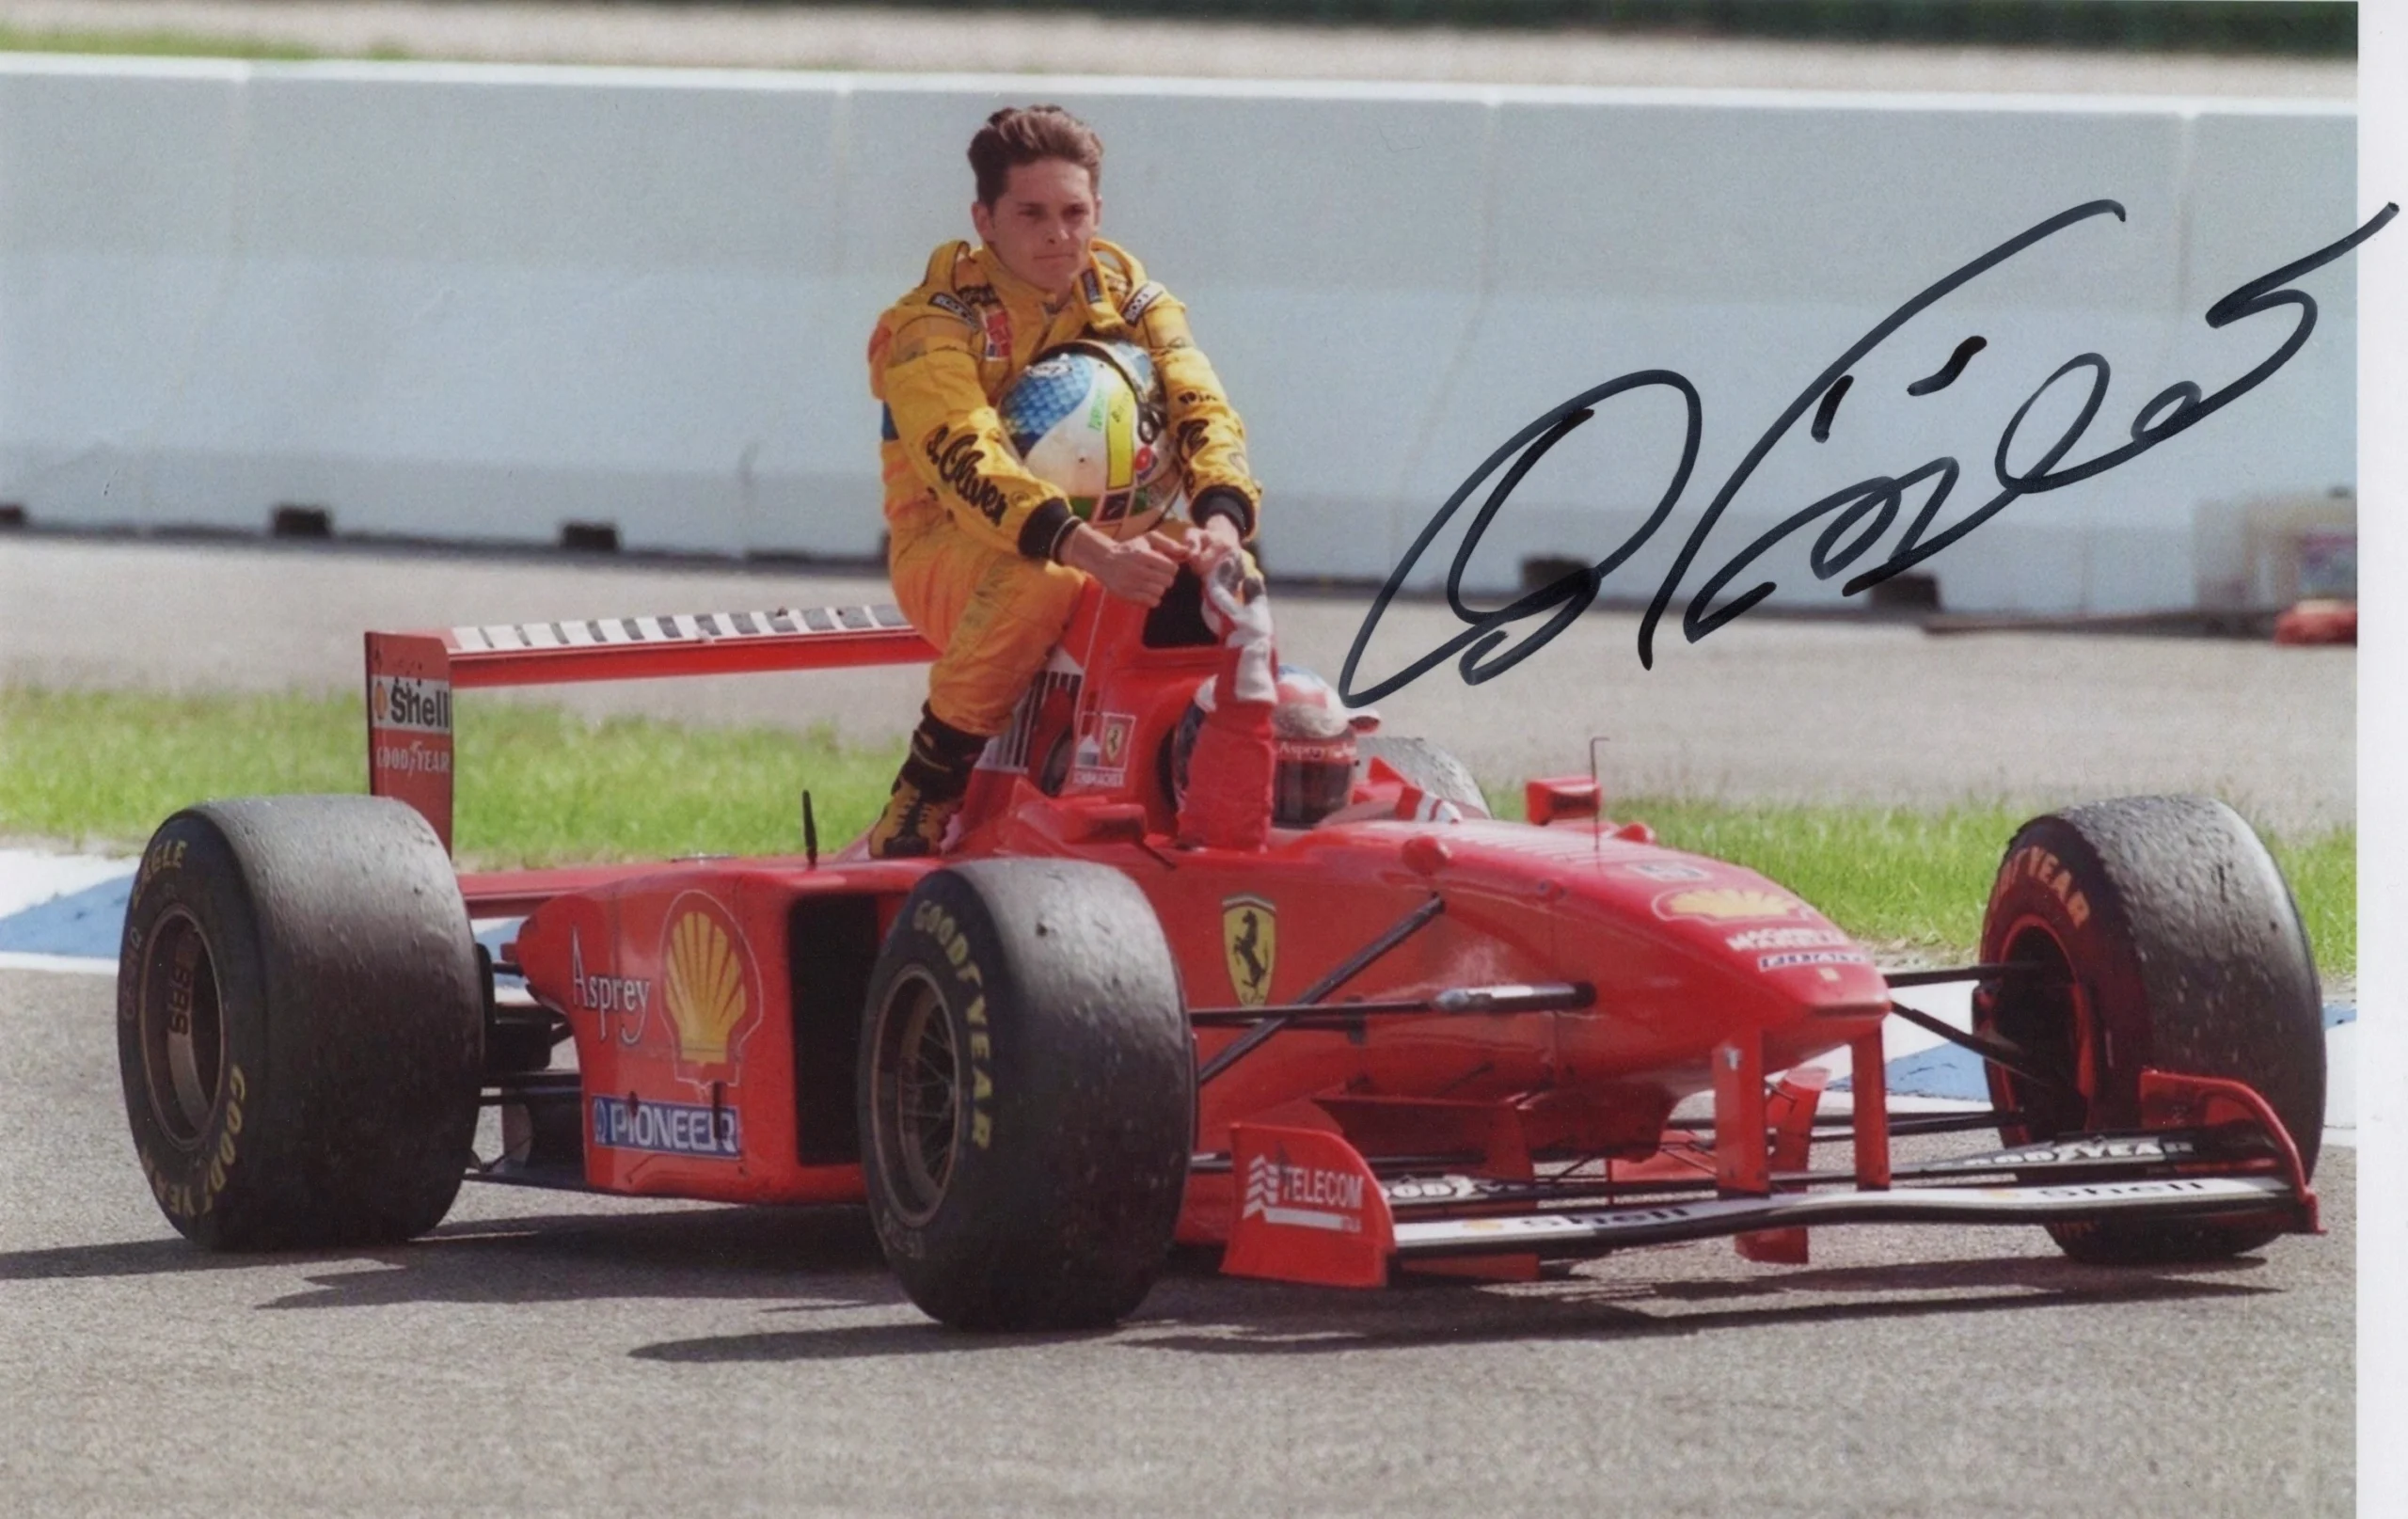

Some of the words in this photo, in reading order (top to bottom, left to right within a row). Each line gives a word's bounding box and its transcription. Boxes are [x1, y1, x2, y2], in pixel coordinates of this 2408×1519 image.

[390, 684, 449, 728] Shell
[377, 741, 449, 776] GOODYEAR
[572, 926, 651, 1045] Asprey
[912, 899, 992, 1150] GOODYEAR
[610, 1103, 737, 1153] PIONEER
[1282, 1165, 1364, 1210] TELECOM
